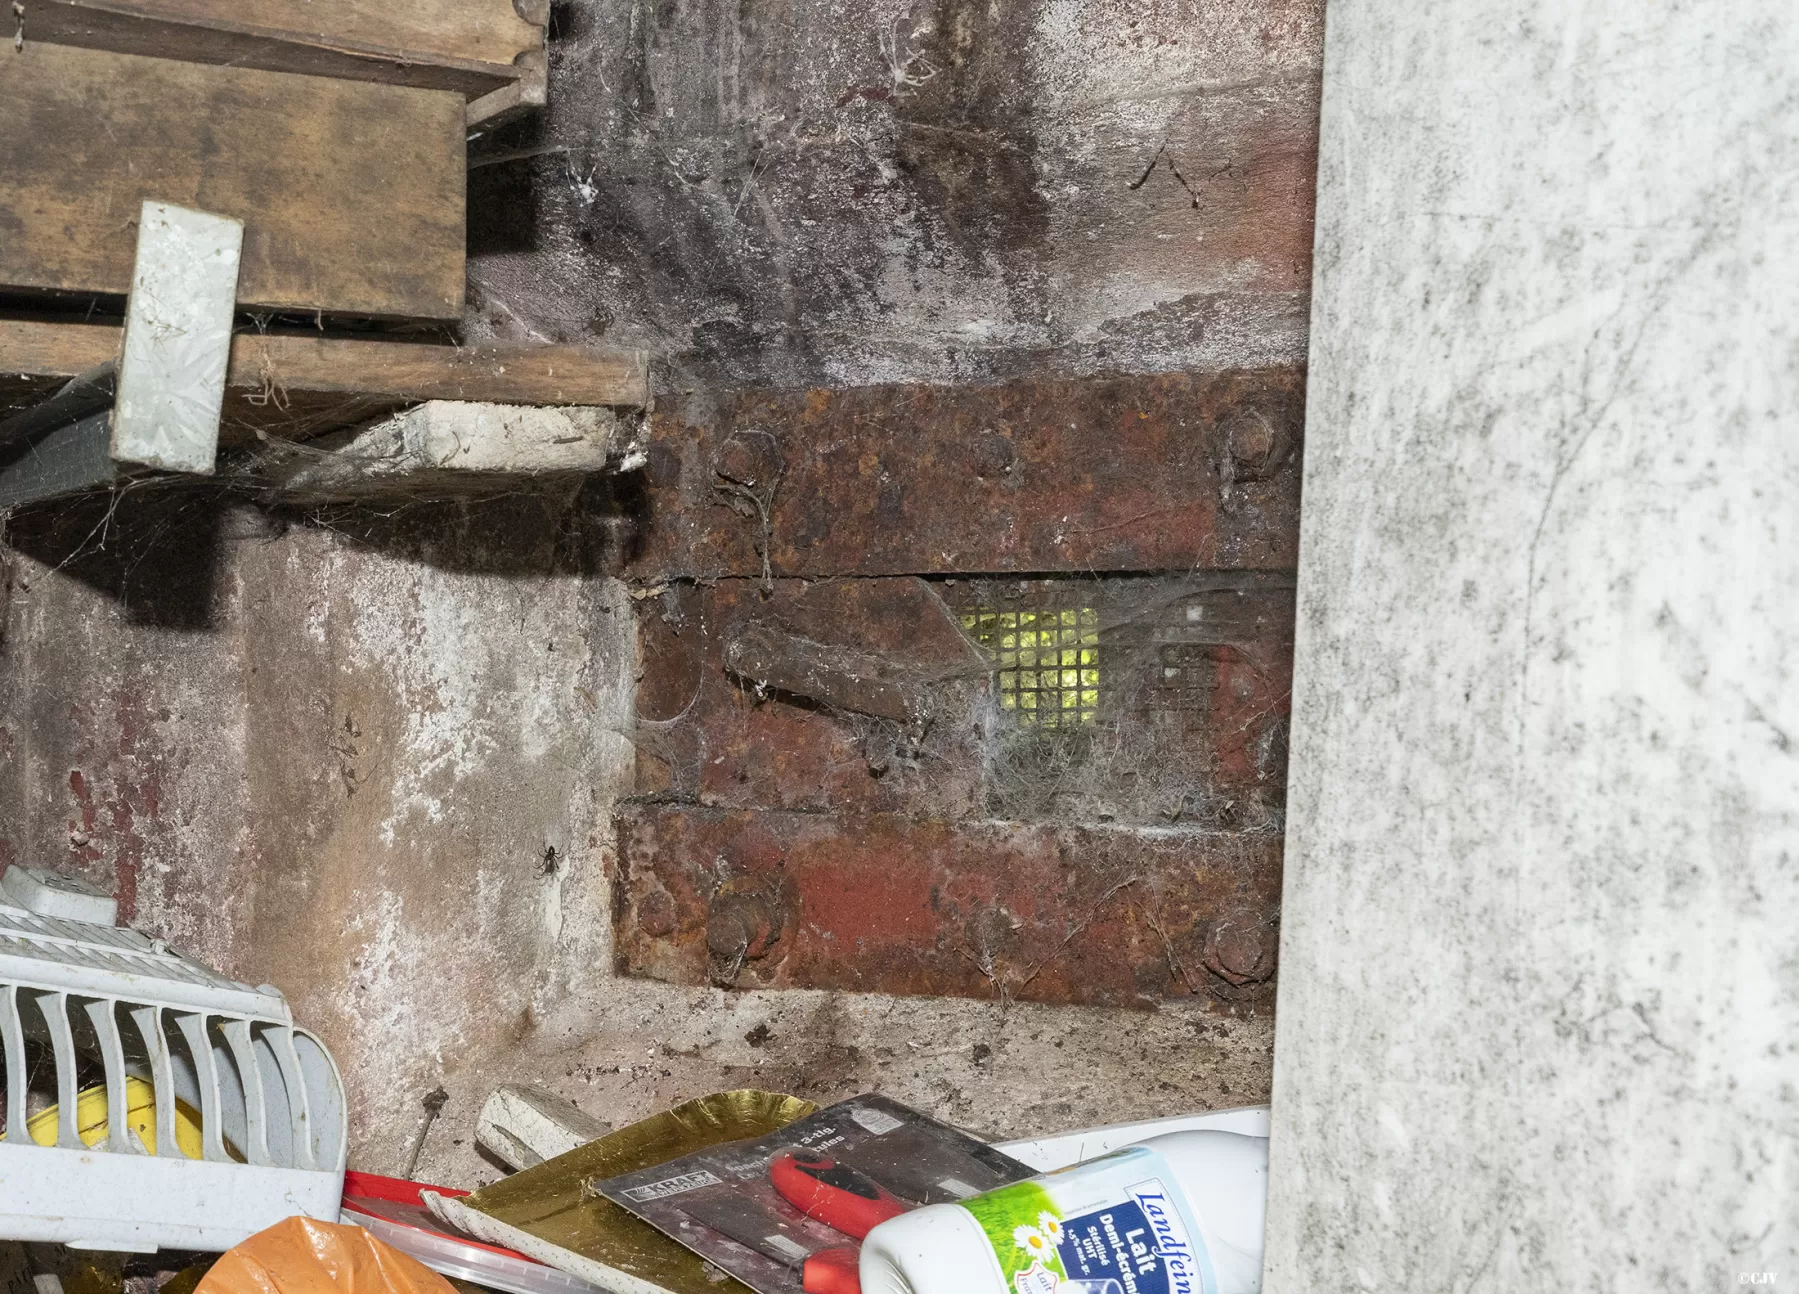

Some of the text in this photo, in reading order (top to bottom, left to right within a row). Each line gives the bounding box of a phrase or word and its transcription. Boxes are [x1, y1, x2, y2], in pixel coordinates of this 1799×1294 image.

[647, 1171, 707, 1192] KRAFT
[1082, 1238, 1097, 1258] UHT
[1087, 1226, 1110, 1266] Stérilisé
[1099, 1213, 1141, 1294] Demi-écrém
[1126, 1228, 1157, 1275] Lait
[1135, 1192, 1193, 1294] Landfein
[1037, 1272, 1052, 1292] Lait
